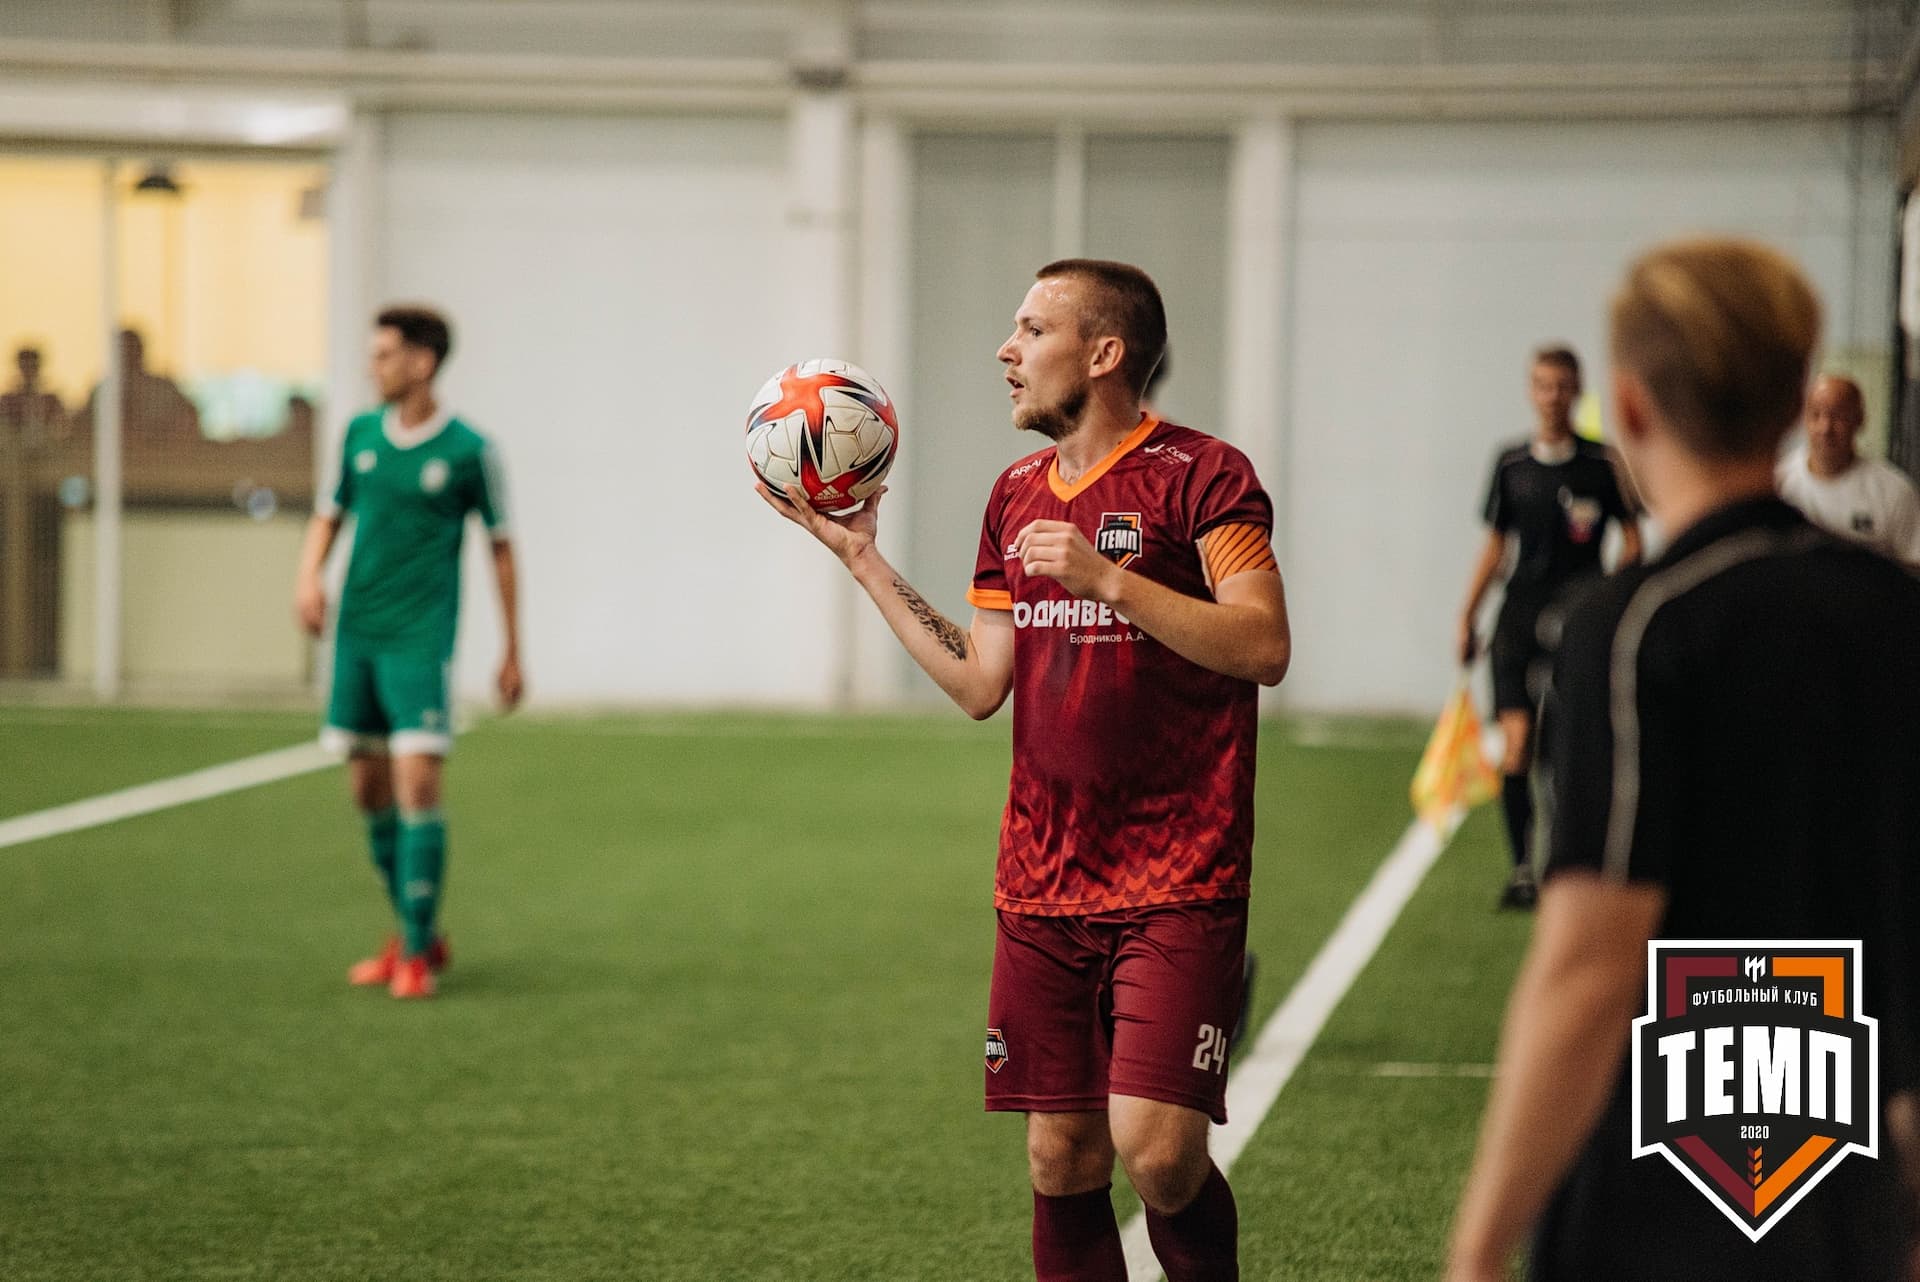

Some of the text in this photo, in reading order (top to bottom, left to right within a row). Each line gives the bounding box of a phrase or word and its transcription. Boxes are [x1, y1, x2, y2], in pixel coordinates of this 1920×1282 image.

[1100, 530, 1138, 551] ТЕМП
[1069, 633, 1122, 645] Бродников
[986, 1041, 1005, 1057] ЕМП
[1192, 1023, 1227, 1075] 24
